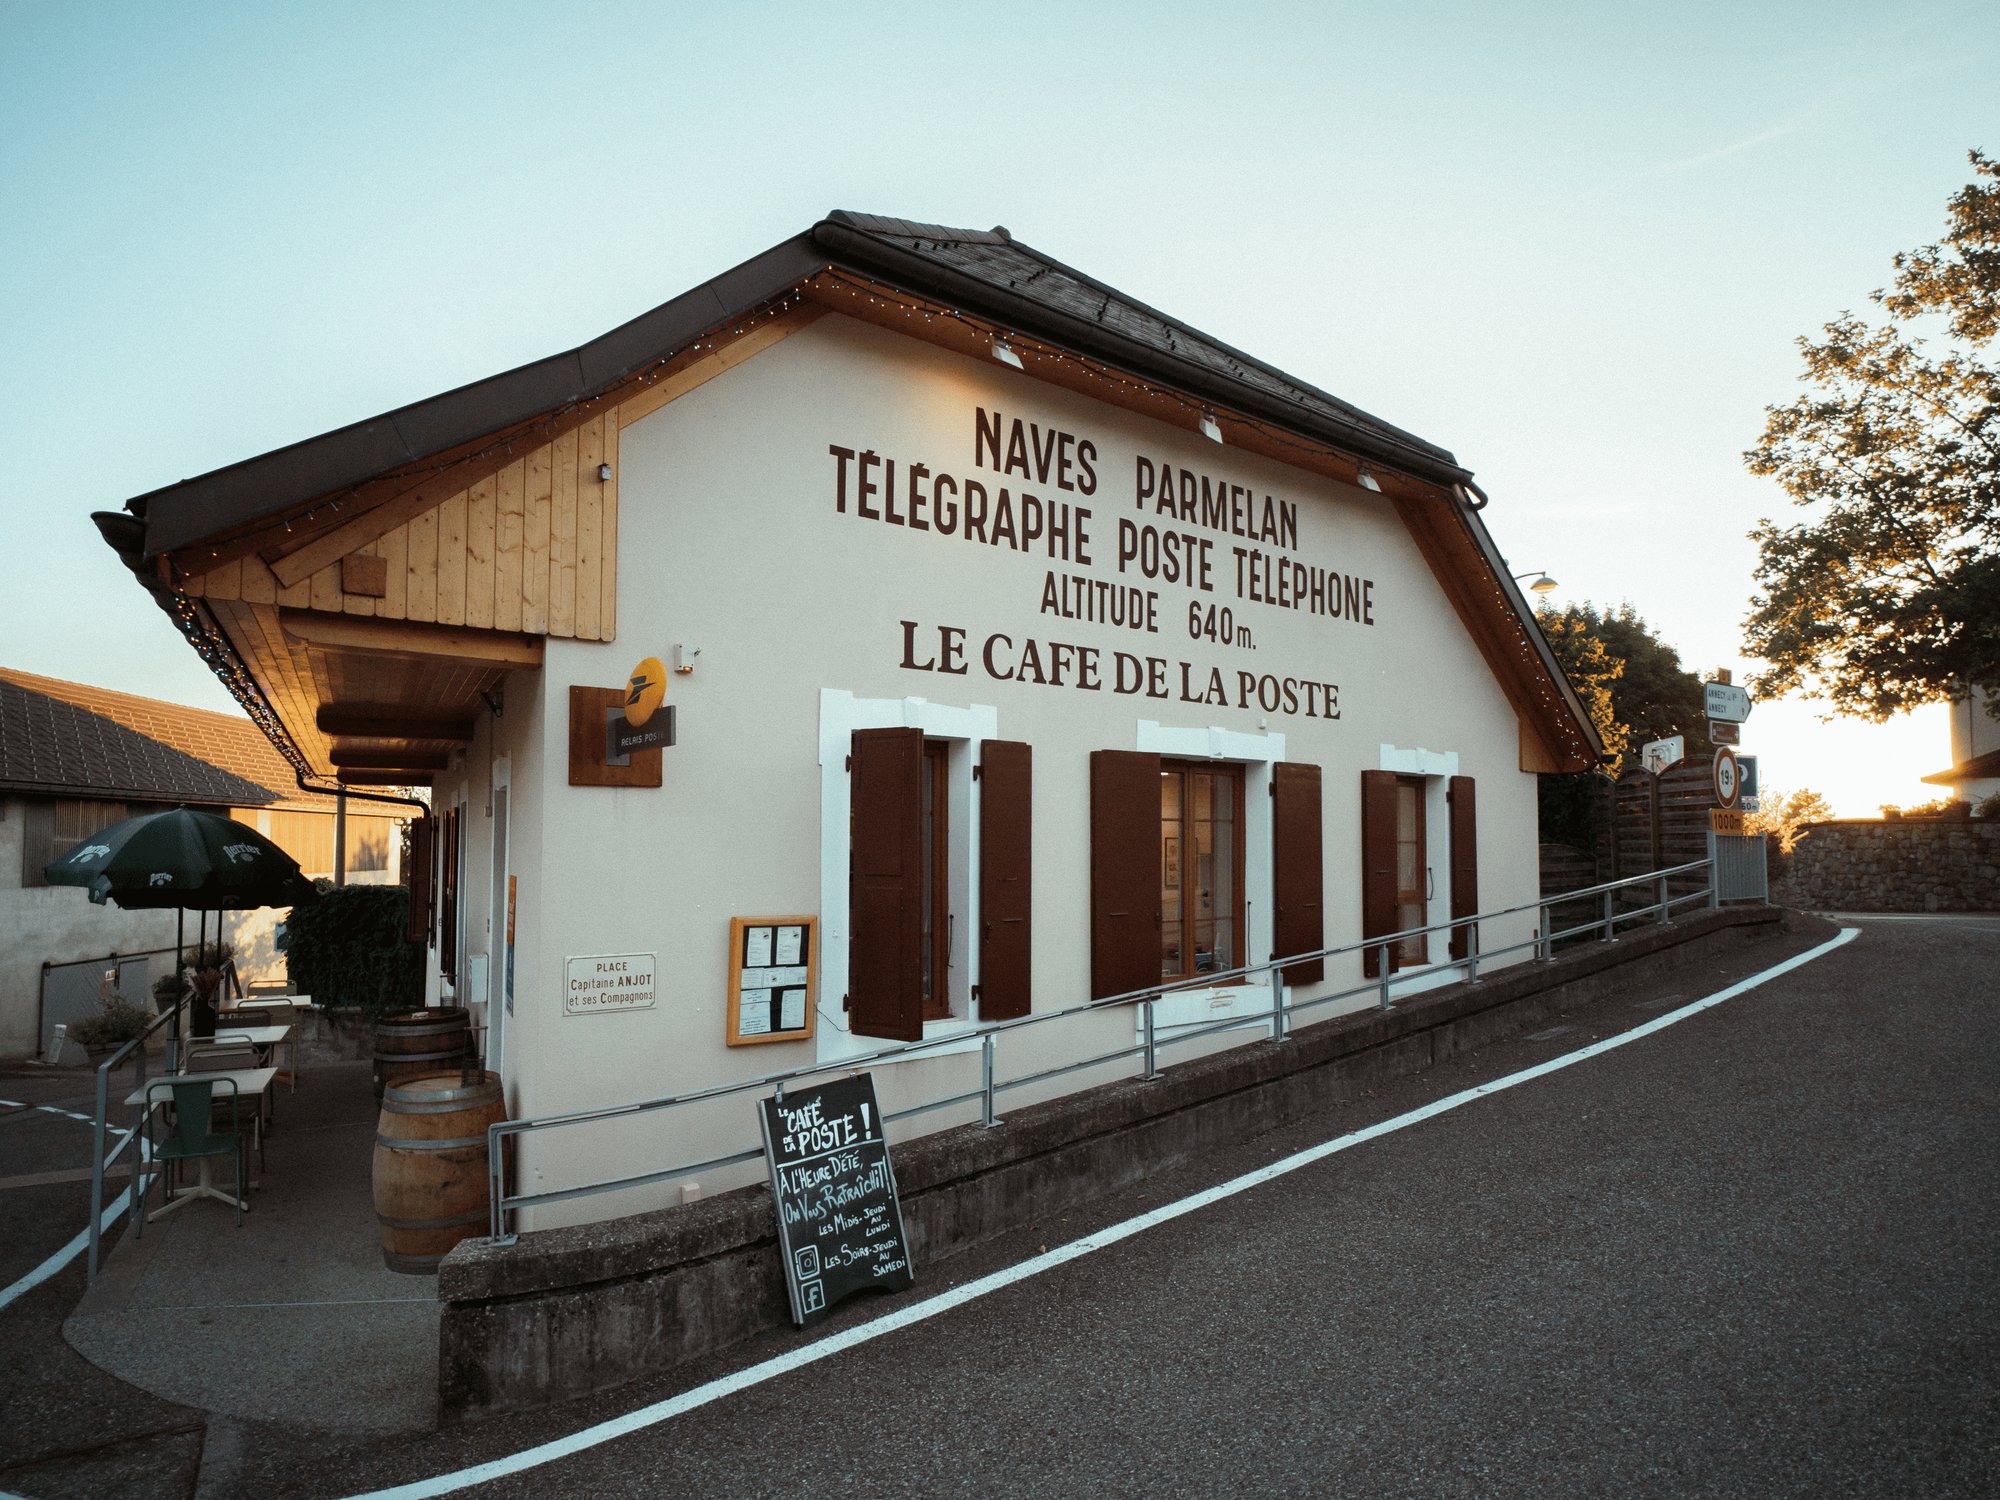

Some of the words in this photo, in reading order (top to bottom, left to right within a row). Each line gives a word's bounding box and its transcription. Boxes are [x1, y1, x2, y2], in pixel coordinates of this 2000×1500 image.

[975, 406, 1098, 497] NAVES
[1136, 455, 1298, 550] PARMELAN
[828, 444, 1092, 566] TÉLÉGRAPHE
[1118, 518, 1214, 592] POSTE
[1233, 547, 1375, 626] TÉLÉPHONE
[1040, 570, 1159, 633] ALTITUDE
[899, 620, 969, 675] LE
[982, 633, 1101, 691] CAFE
[1113, 652, 1169, 699] DE
[1179, 662, 1229, 707] LA
[1237, 670, 1342, 720] POSTE
[1708, 703, 1727, 713] ANNECY
[621, 735, 642, 747] RELAIS
[597, 962, 628, 972] PLACE
[571, 978, 614, 992] Capitaine
[618, 974, 652, 987] ANJOT
[569, 995, 579, 1006] et
[582, 995, 597, 1006] ses
[600, 991, 653, 1005] Compagnons
[787, 1096, 825, 1133] CAFÉ
[782, 1134, 794, 1145] DE
[797, 1114, 858, 1157] POSTE
[784, 1142, 796, 1153] LA
[871, 1216, 882, 1225] AU
[819, 1223, 834, 1236] LES
[824, 1256, 841, 1269] LES
[879, 1252, 890, 1262] AU
